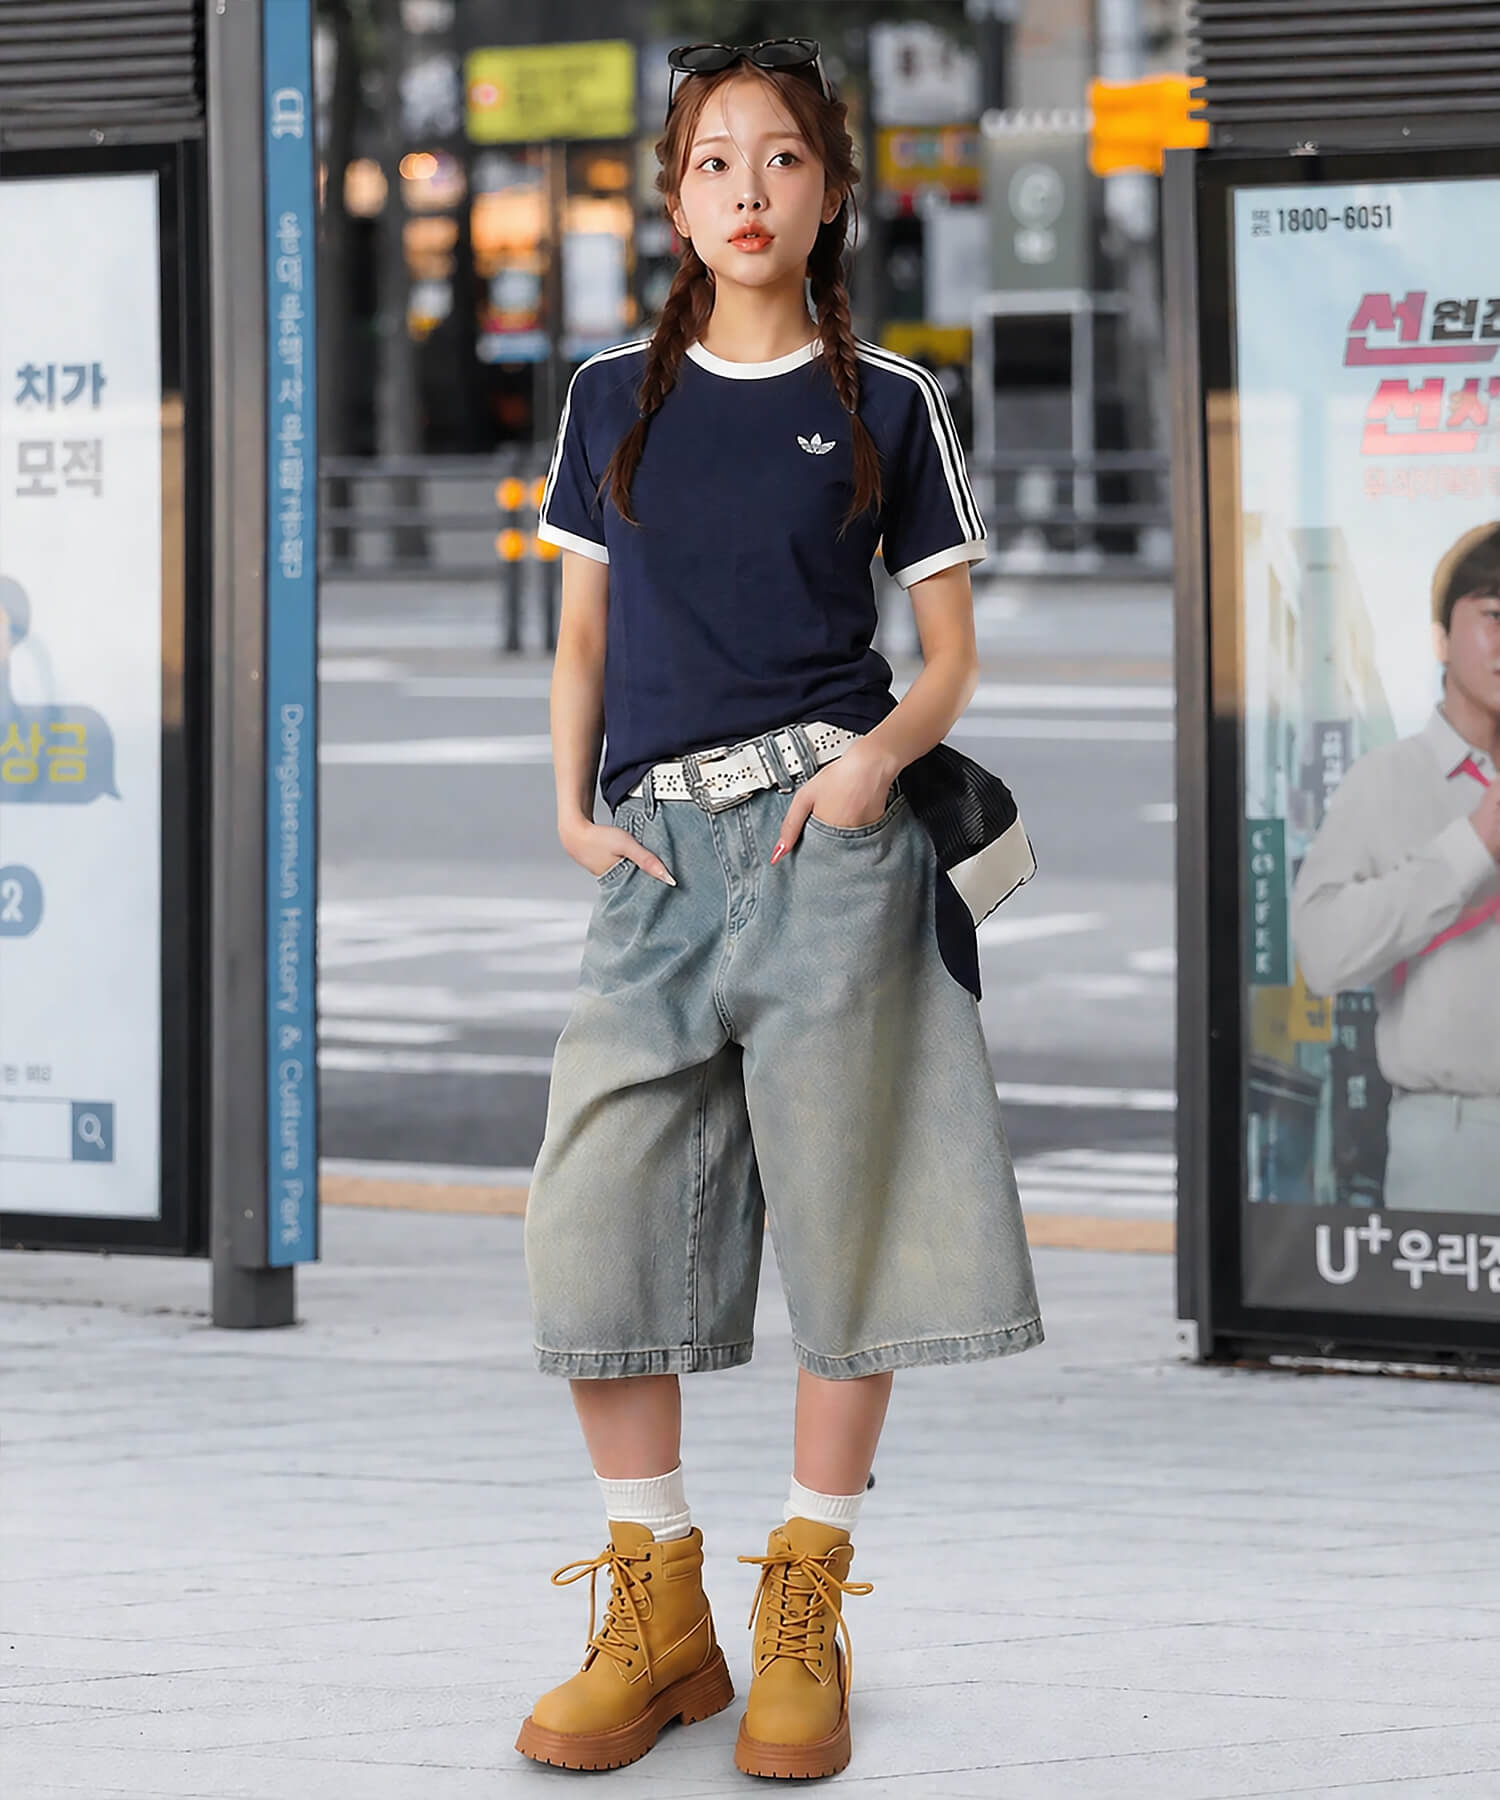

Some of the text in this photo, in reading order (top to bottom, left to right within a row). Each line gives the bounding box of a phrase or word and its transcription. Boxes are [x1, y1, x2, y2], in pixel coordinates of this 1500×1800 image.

[1277, 205, 1392, 233] 1800-6051
[15, 362, 106, 411] 치가
[15, 438, 104, 497] 모적
[0, 722, 88, 784] 상금
[275, 703, 305, 1245] Dongdaemun History & Culture Park
